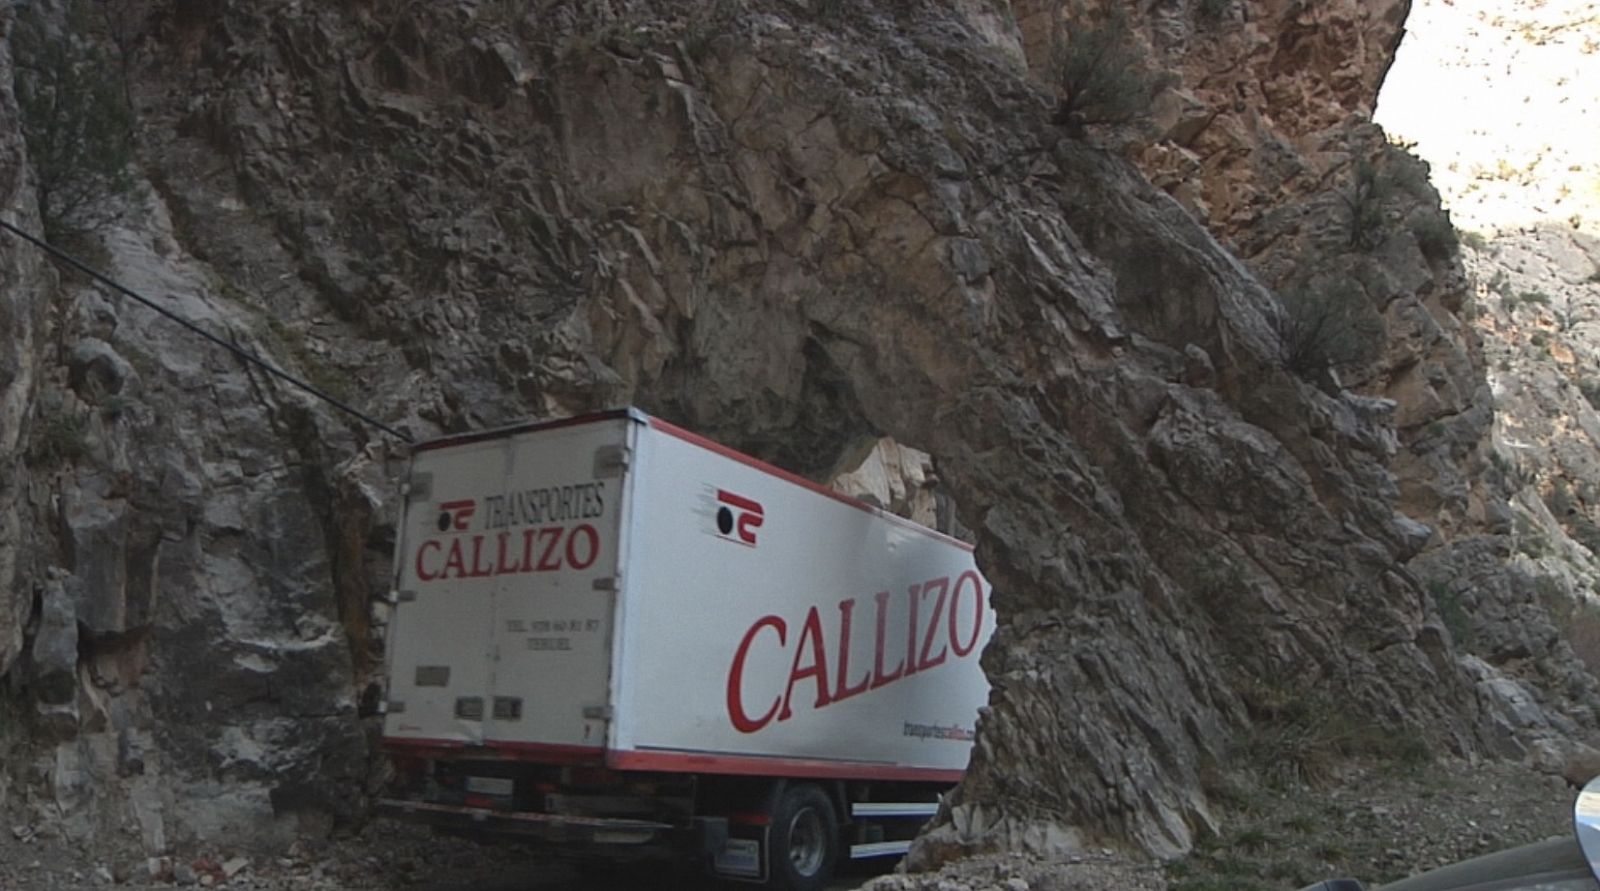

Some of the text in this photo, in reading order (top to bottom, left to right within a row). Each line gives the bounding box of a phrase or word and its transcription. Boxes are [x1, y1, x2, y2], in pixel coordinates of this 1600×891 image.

[485, 482, 605, 530] TRANSPORTES
[416, 524, 600, 582] CALLIZO
[727, 570, 984, 734] CALLIZO
